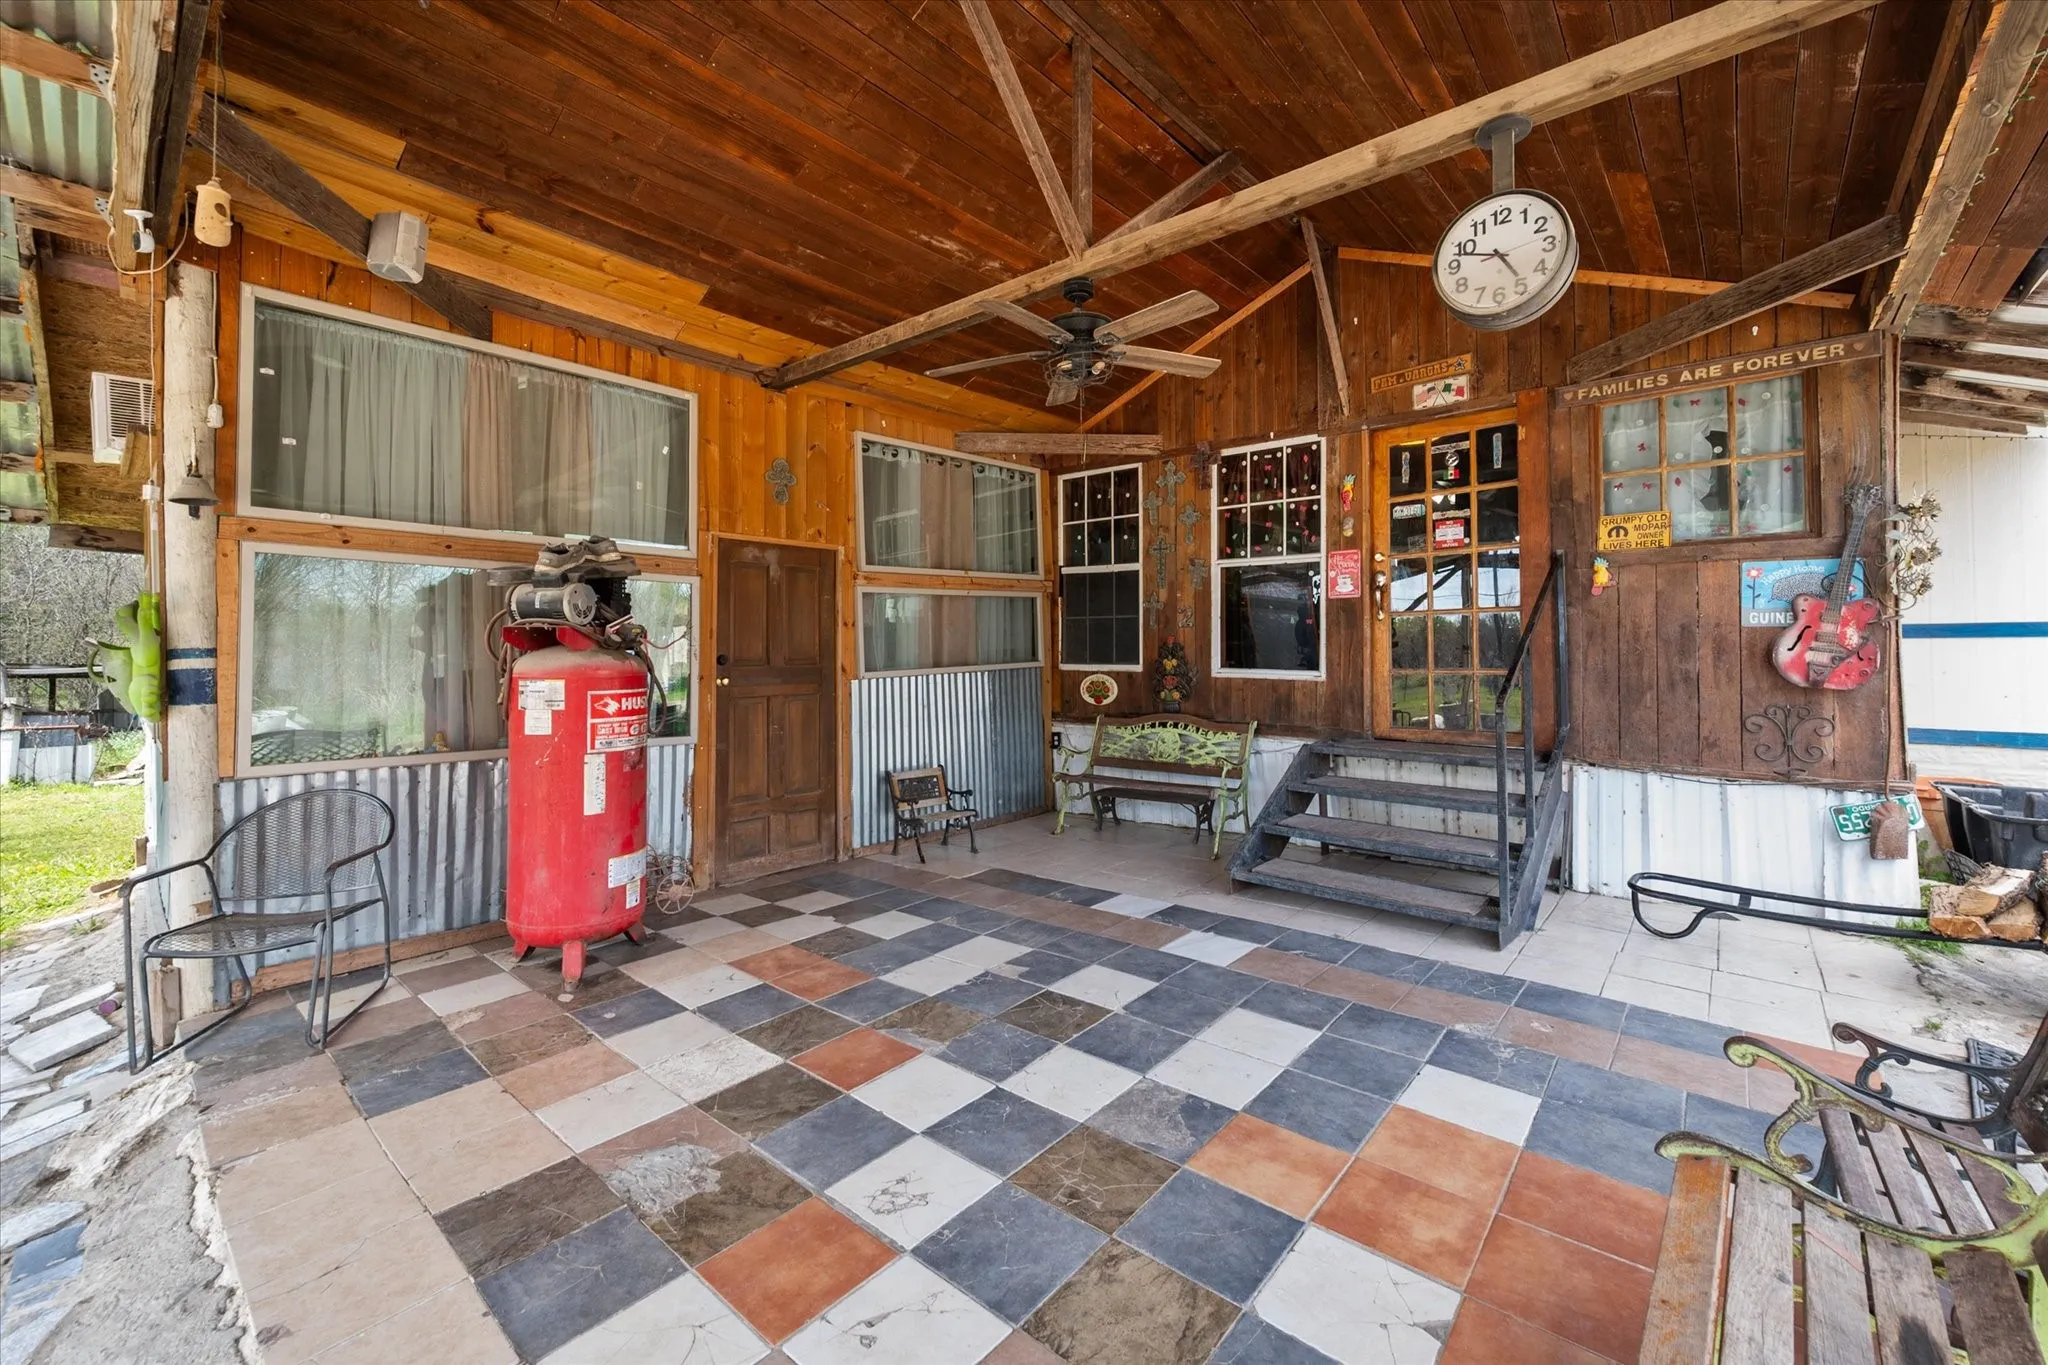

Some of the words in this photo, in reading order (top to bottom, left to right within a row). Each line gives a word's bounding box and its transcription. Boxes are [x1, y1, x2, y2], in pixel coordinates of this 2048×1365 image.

[1490, 207, 1512, 226] 12
[1519, 208, 1529, 224] 1
[1470, 219, 1487, 237] 11
[1533, 216, 1548, 234] 2
[1454, 238, 1477, 256] 10
[1542, 235, 1556, 252] 3
[1448, 259, 1461, 275] 9
[1533, 258, 1549, 276] 4
[1455, 277, 1468, 294] 8
[1514, 277, 1529, 296] 5
[1474, 286, 1487, 304] 7
[1492, 287, 1505, 304] 6
[1577, 374, 1669, 400] FAMILIES
[1679, 364, 1722, 383] ARE
[1733, 343, 1845, 374] FOREVER
[1601, 515, 1643, 526] GRUMPY
[1646, 513, 1668, 523] OLD
[1633, 522, 1667, 532] MOPAR
[1637, 530, 1664, 540] OWNER
[1603, 540, 1632, 550] LIVES
[1635, 539, 1665, 548] HERE
[1760, 567, 1793, 585] Happy
[1793, 564, 1826, 573] Home
[1132, 720, 1208, 737] WELCOME
